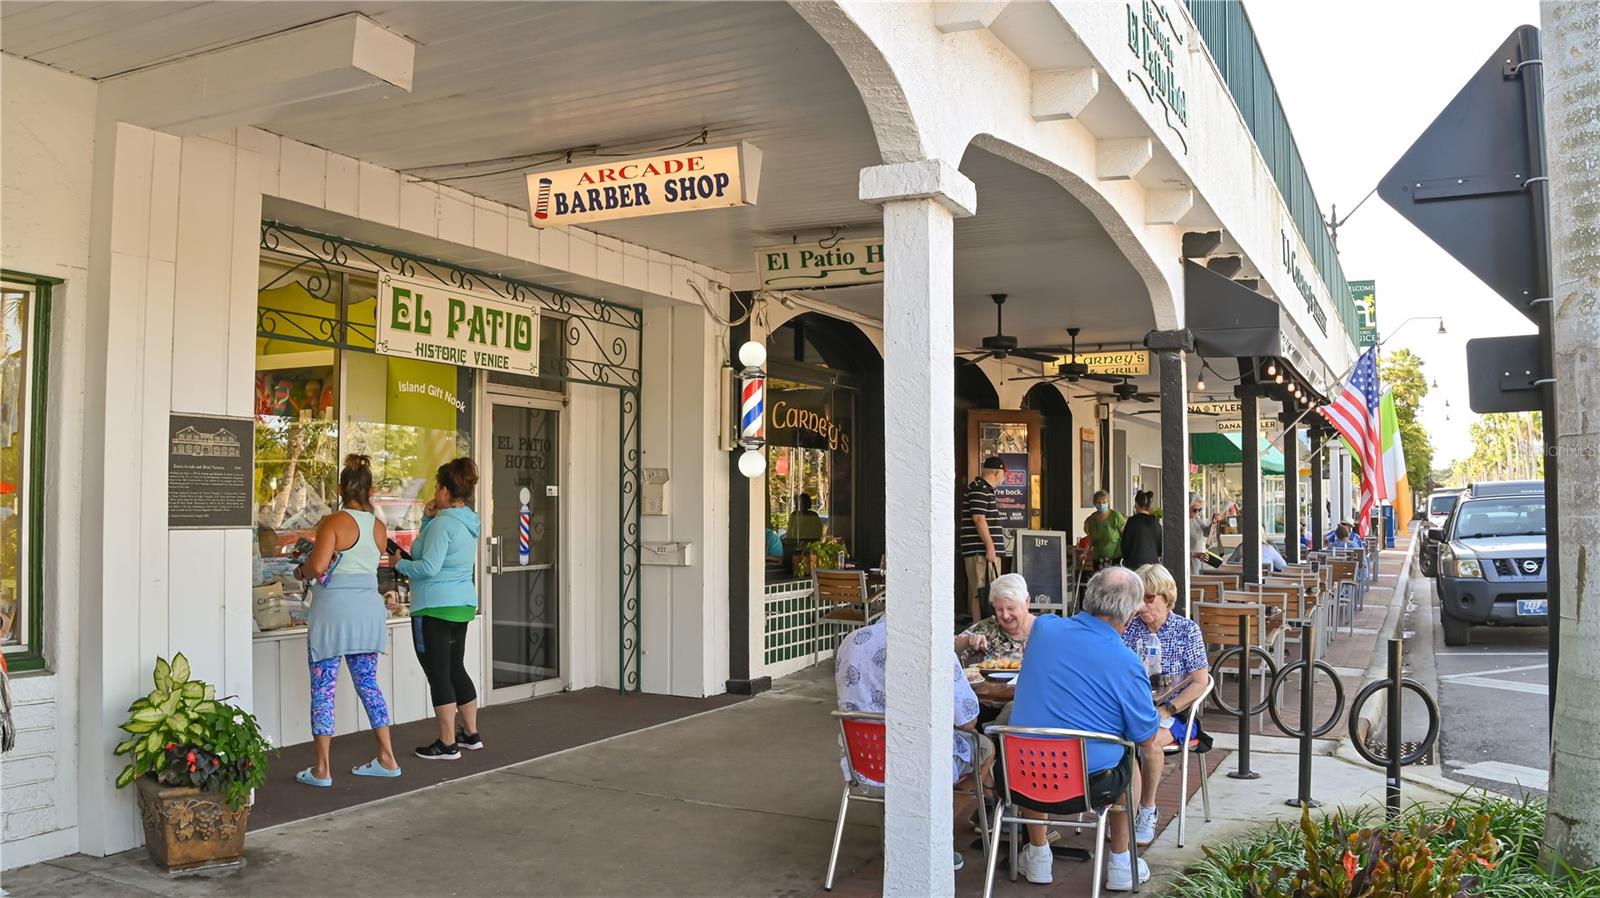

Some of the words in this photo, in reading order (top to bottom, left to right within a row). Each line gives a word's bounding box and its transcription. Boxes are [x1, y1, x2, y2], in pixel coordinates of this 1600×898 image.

[1126, 3, 1140, 59] El
[1142, 27, 1166, 97] Patio
[576, 156, 705, 186] ARCADE
[554, 182, 650, 216] BARBER
[664, 172, 730, 203] SHOP
[766, 252, 790, 271] El
[800, 248, 855, 269] Patio
[390, 286, 432, 335] EL
[446, 297, 532, 352] PATIO
[415, 342, 467, 365] HISTORIC
[473, 351, 510, 370] VENICE
[398, 381, 425, 394] Island
[427, 384, 443, 399] Gift
[444, 393, 466, 413] Nook
[772, 400, 849, 454] Carney's
[496, 435, 514, 450] EL
[518, 437, 552, 453] PATIO
[505, 454, 545, 470] HOTEL
[1035, 537, 1048, 547] Lite
